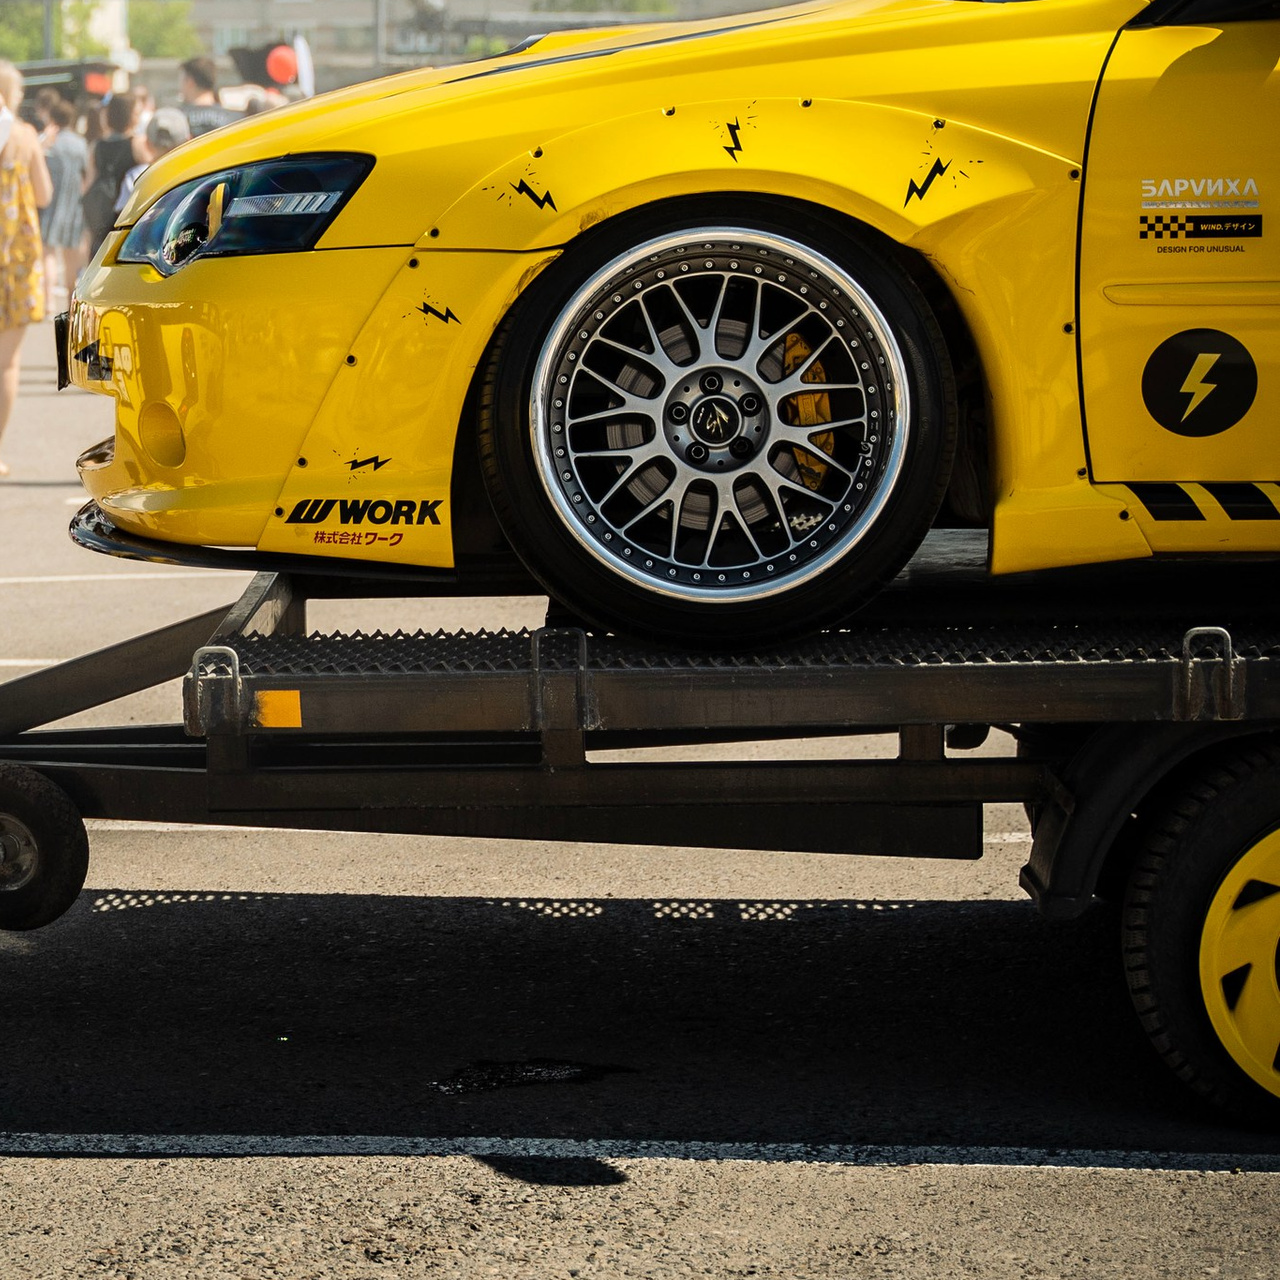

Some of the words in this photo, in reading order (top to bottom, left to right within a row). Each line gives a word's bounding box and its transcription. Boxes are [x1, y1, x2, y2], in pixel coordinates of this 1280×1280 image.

[1157, 246, 1187, 254] DESIGN
[1206, 245, 1245, 253] UNUSUAL
[339, 499, 444, 525] WORK
